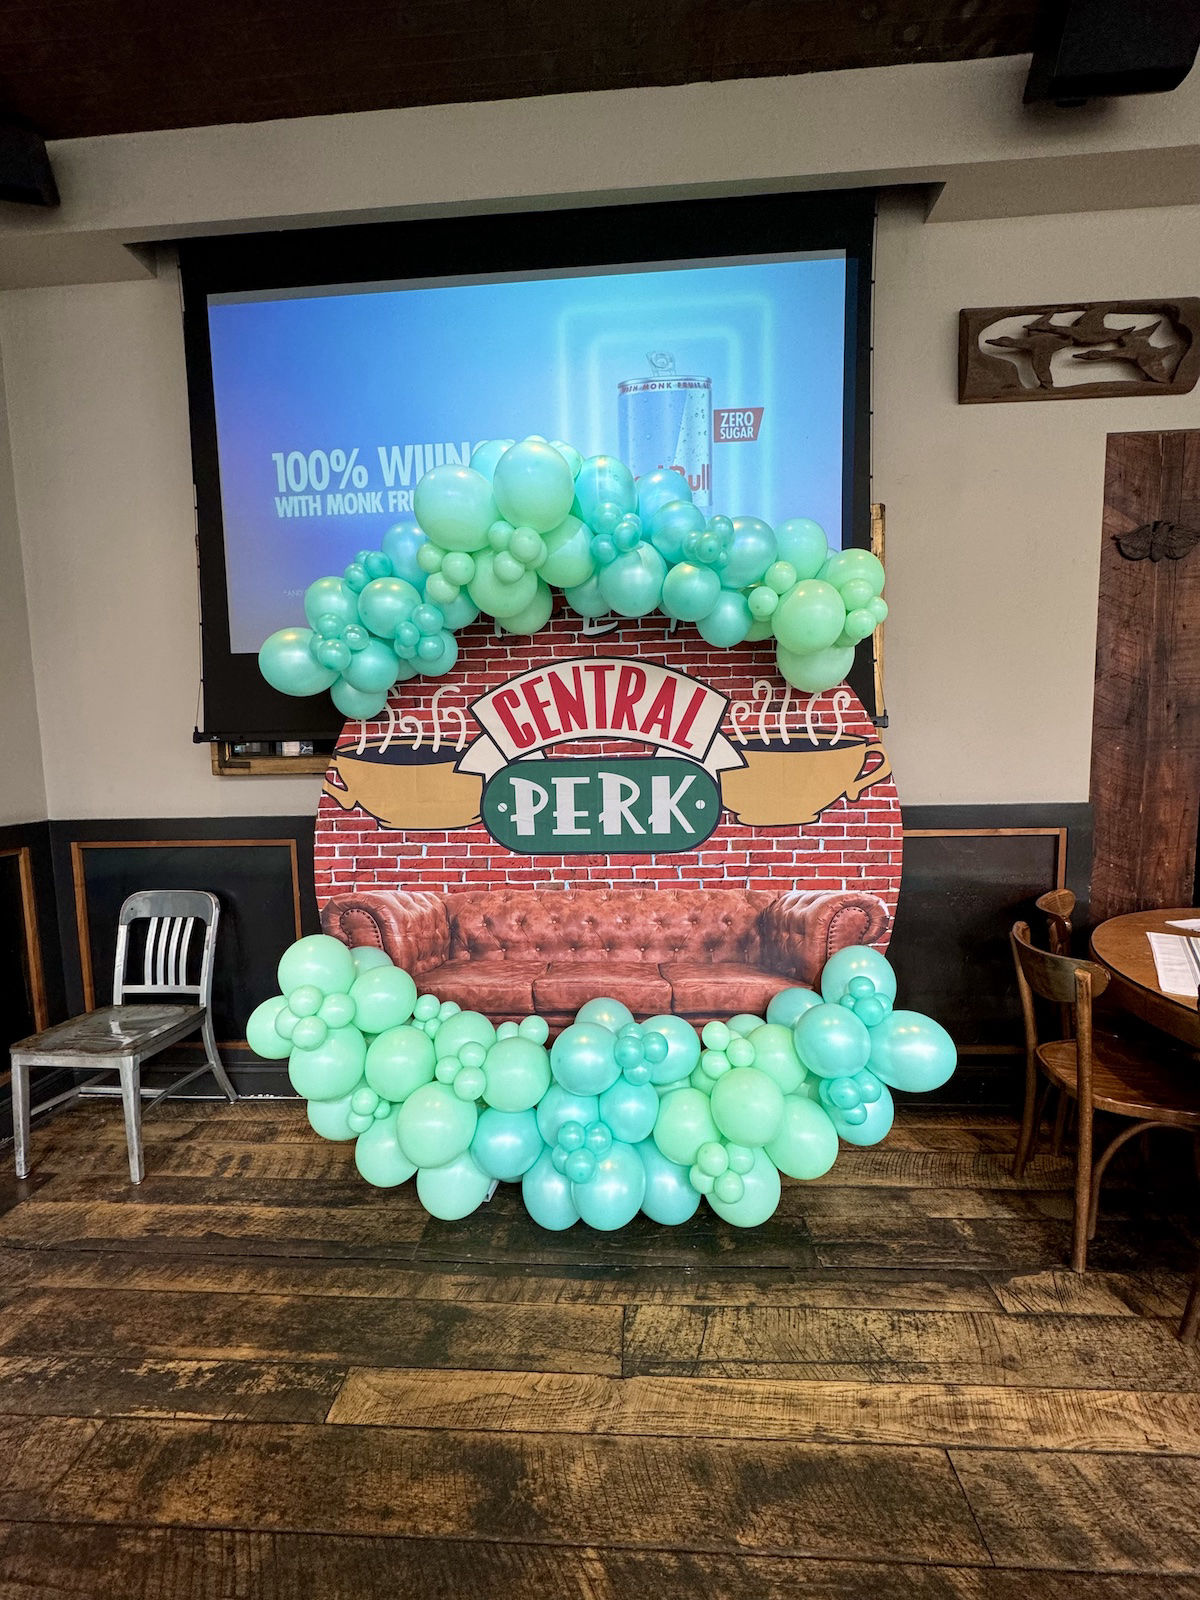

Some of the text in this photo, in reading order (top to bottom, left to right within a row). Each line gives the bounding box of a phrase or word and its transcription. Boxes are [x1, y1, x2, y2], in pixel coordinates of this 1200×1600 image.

[642, 382, 673, 391] MONK
[720, 411, 754, 428] ZERO
[720, 426, 754, 440] SUGAR
[271, 447, 369, 493] 100%
[668, 463, 710, 491] ull
[274, 495, 322, 519] WITH
[326, 491, 384, 515] MONK
[491, 664, 708, 750] CENTRAL
[509, 771, 698, 836] PERK
